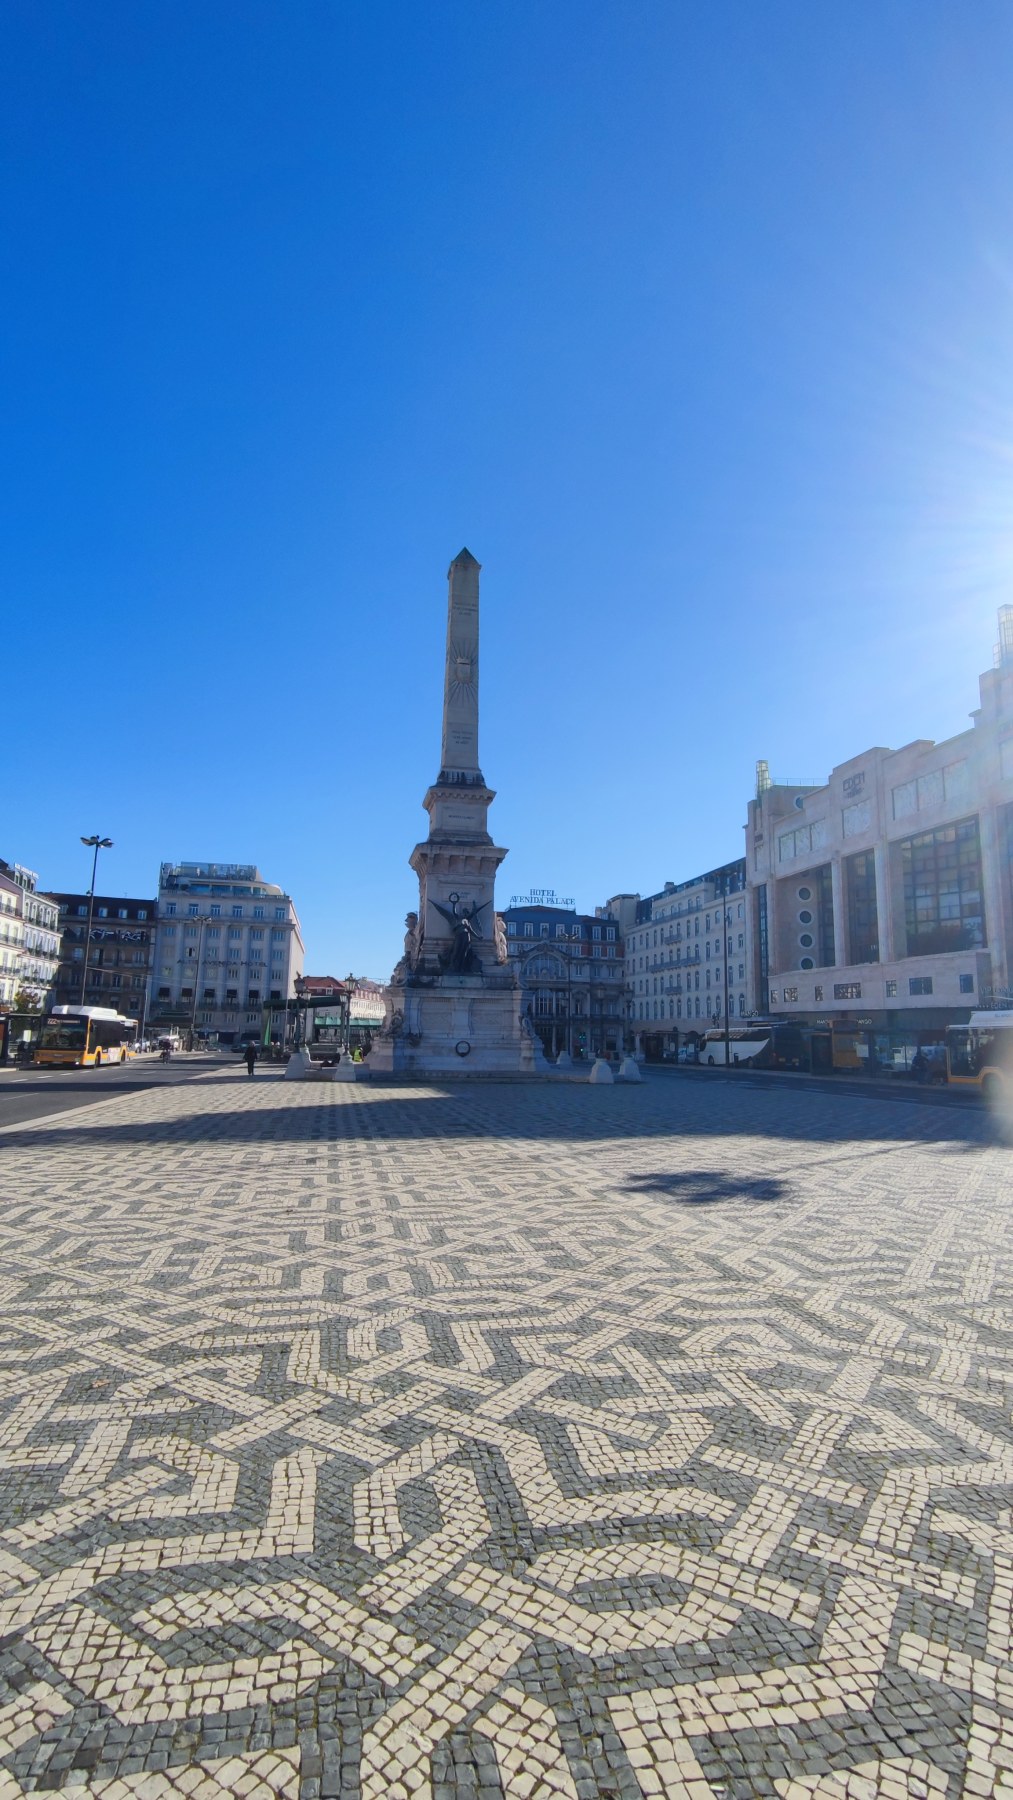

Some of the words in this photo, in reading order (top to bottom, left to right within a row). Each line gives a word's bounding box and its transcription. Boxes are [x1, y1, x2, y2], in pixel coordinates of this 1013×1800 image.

[843, 771, 865, 791] EDEN
[529, 888, 557, 897] HOTEL
[509, 895, 543, 904] AVENIDA
[546, 897, 576, 905] PALACE
[740, 1009, 759, 1017] MANGO
